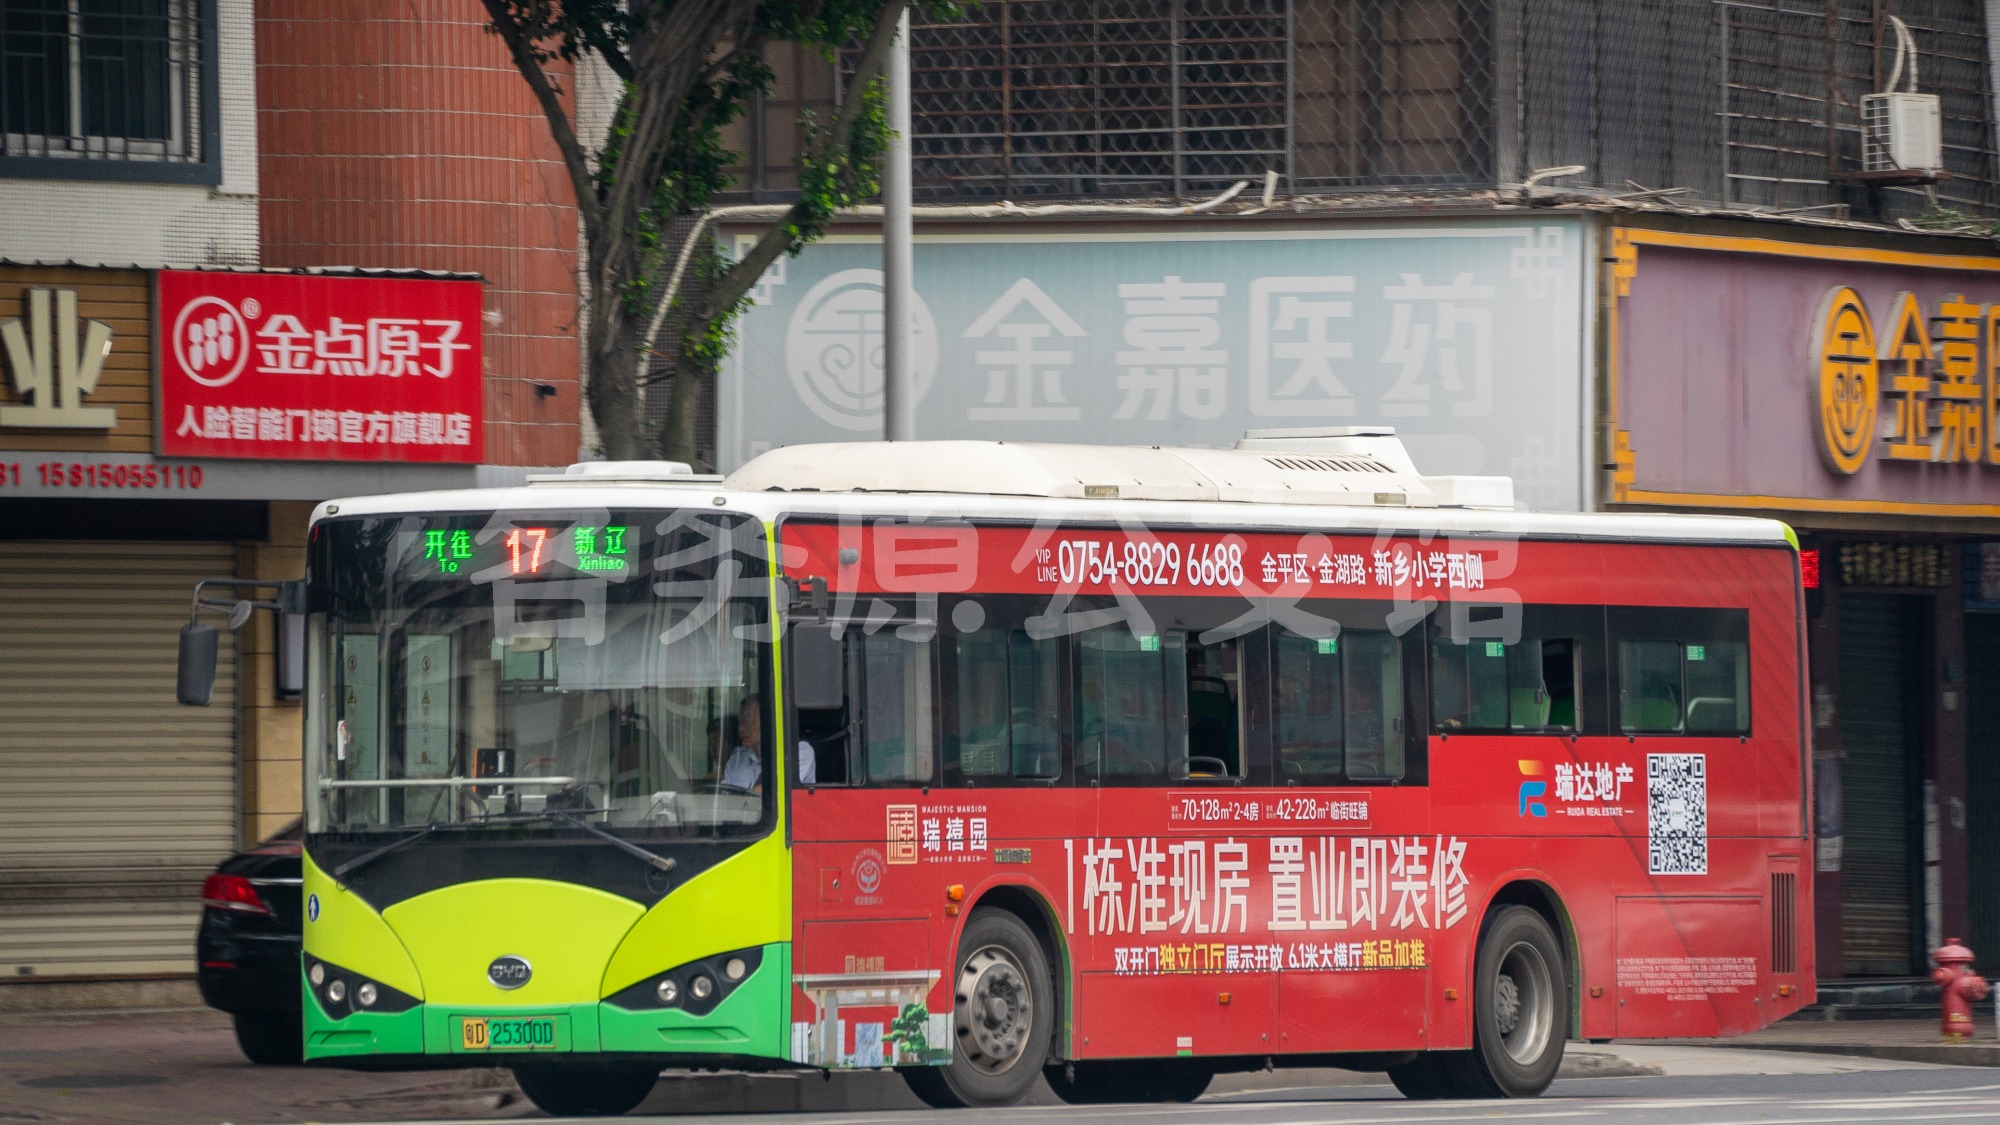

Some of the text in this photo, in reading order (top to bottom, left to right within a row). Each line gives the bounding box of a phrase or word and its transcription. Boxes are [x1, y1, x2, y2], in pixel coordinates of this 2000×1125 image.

[0, 286, 117, 428] 业
[255, 314, 472, 379] 金点原子
[961, 272, 1497, 422] 金嘉医药
[1880, 291, 2000, 466] 金嘉
[175, 404, 472, 446] 人脸智能门锁官方旗舰店
[37, 462, 204, 488] 15815055110
[424, 526, 628, 574] 开往 17 新辽
[438, 556, 626, 573] To Xinliao
[1035, 548, 1051, 564] VIP
[1058, 540, 1245, 587] 0754-8829 6688
[1036, 566, 1059, 583] LINE
[1554, 762, 1634, 802] 瑞达地产
[921, 805, 987, 814] MAJESTIC MANSION
[1330, 801, 1369, 821] 临街旺铺
[1567, 806, 1623, 816] RUIDA REAL ESTATE
[922, 817, 988, 852] 瑞禧园
[1063, 833, 1470, 936] 1栋准现房 置业即装修
[492, 964, 526, 979] BYD
